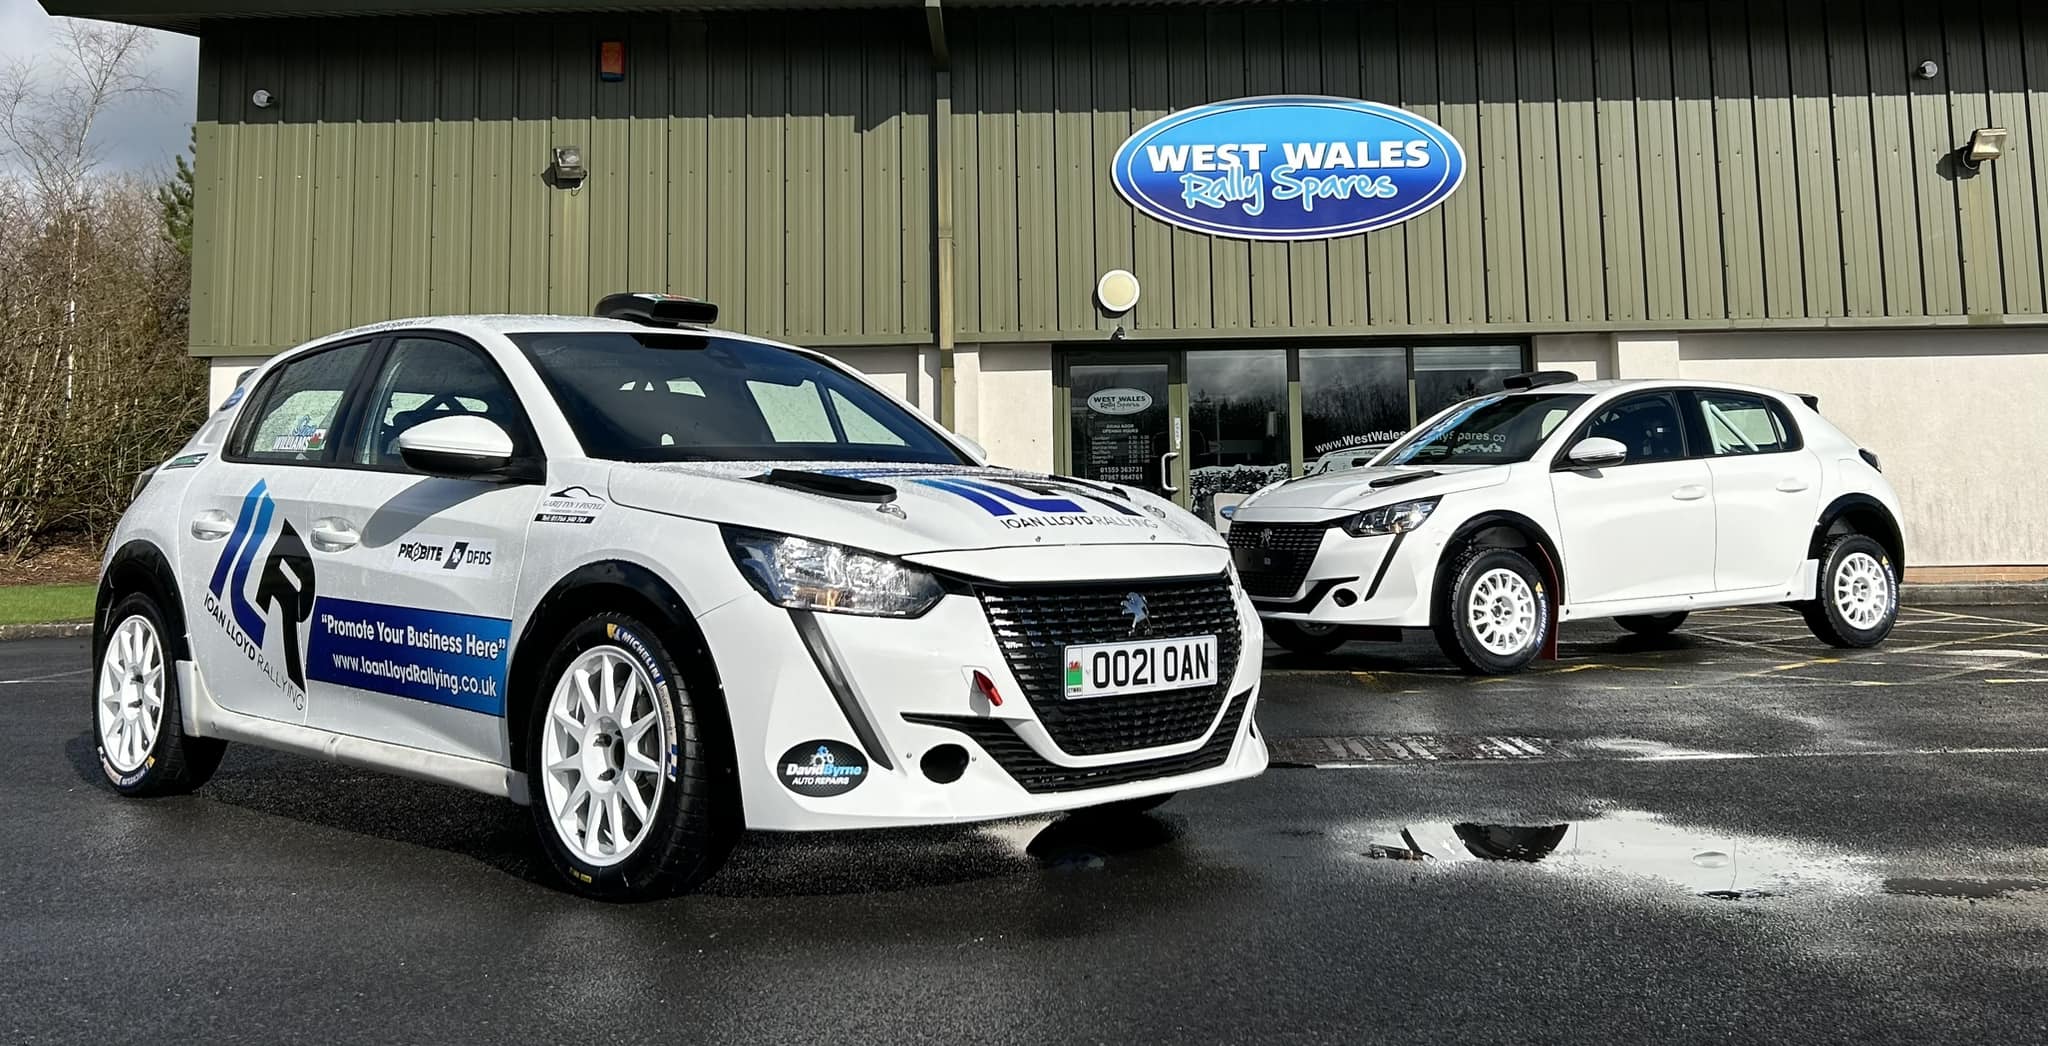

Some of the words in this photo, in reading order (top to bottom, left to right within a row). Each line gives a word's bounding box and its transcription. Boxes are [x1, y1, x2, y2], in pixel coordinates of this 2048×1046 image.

[1146, 144, 1267, 173] WEST
[1283, 140, 1431, 169] WALES
[1179, 164, 1265, 216] Rally
[1270, 165, 1398, 211] Spares
[272, 434, 309, 451] WILLIAMS
[1000, 517, 1045, 530] IOAN
[1045, 515, 1094, 529] LLOYD
[1094, 516, 1158, 531] RALLYING
[466, 550, 492, 566] DFDS
[203, 592, 227, 628] IOAN
[225, 618, 256, 661] LLOYD
[256, 654, 305, 712] RALLYING
[376, 622, 405, 644] Your
[406, 626, 463, 654] Business
[621, 630, 661, 679] MICHELIN
[332, 653, 497, 697] www.IoanLloydRallying.co.uk
[792, 777, 814, 785] AUTO
[815, 776, 850, 785] REPAIRS
